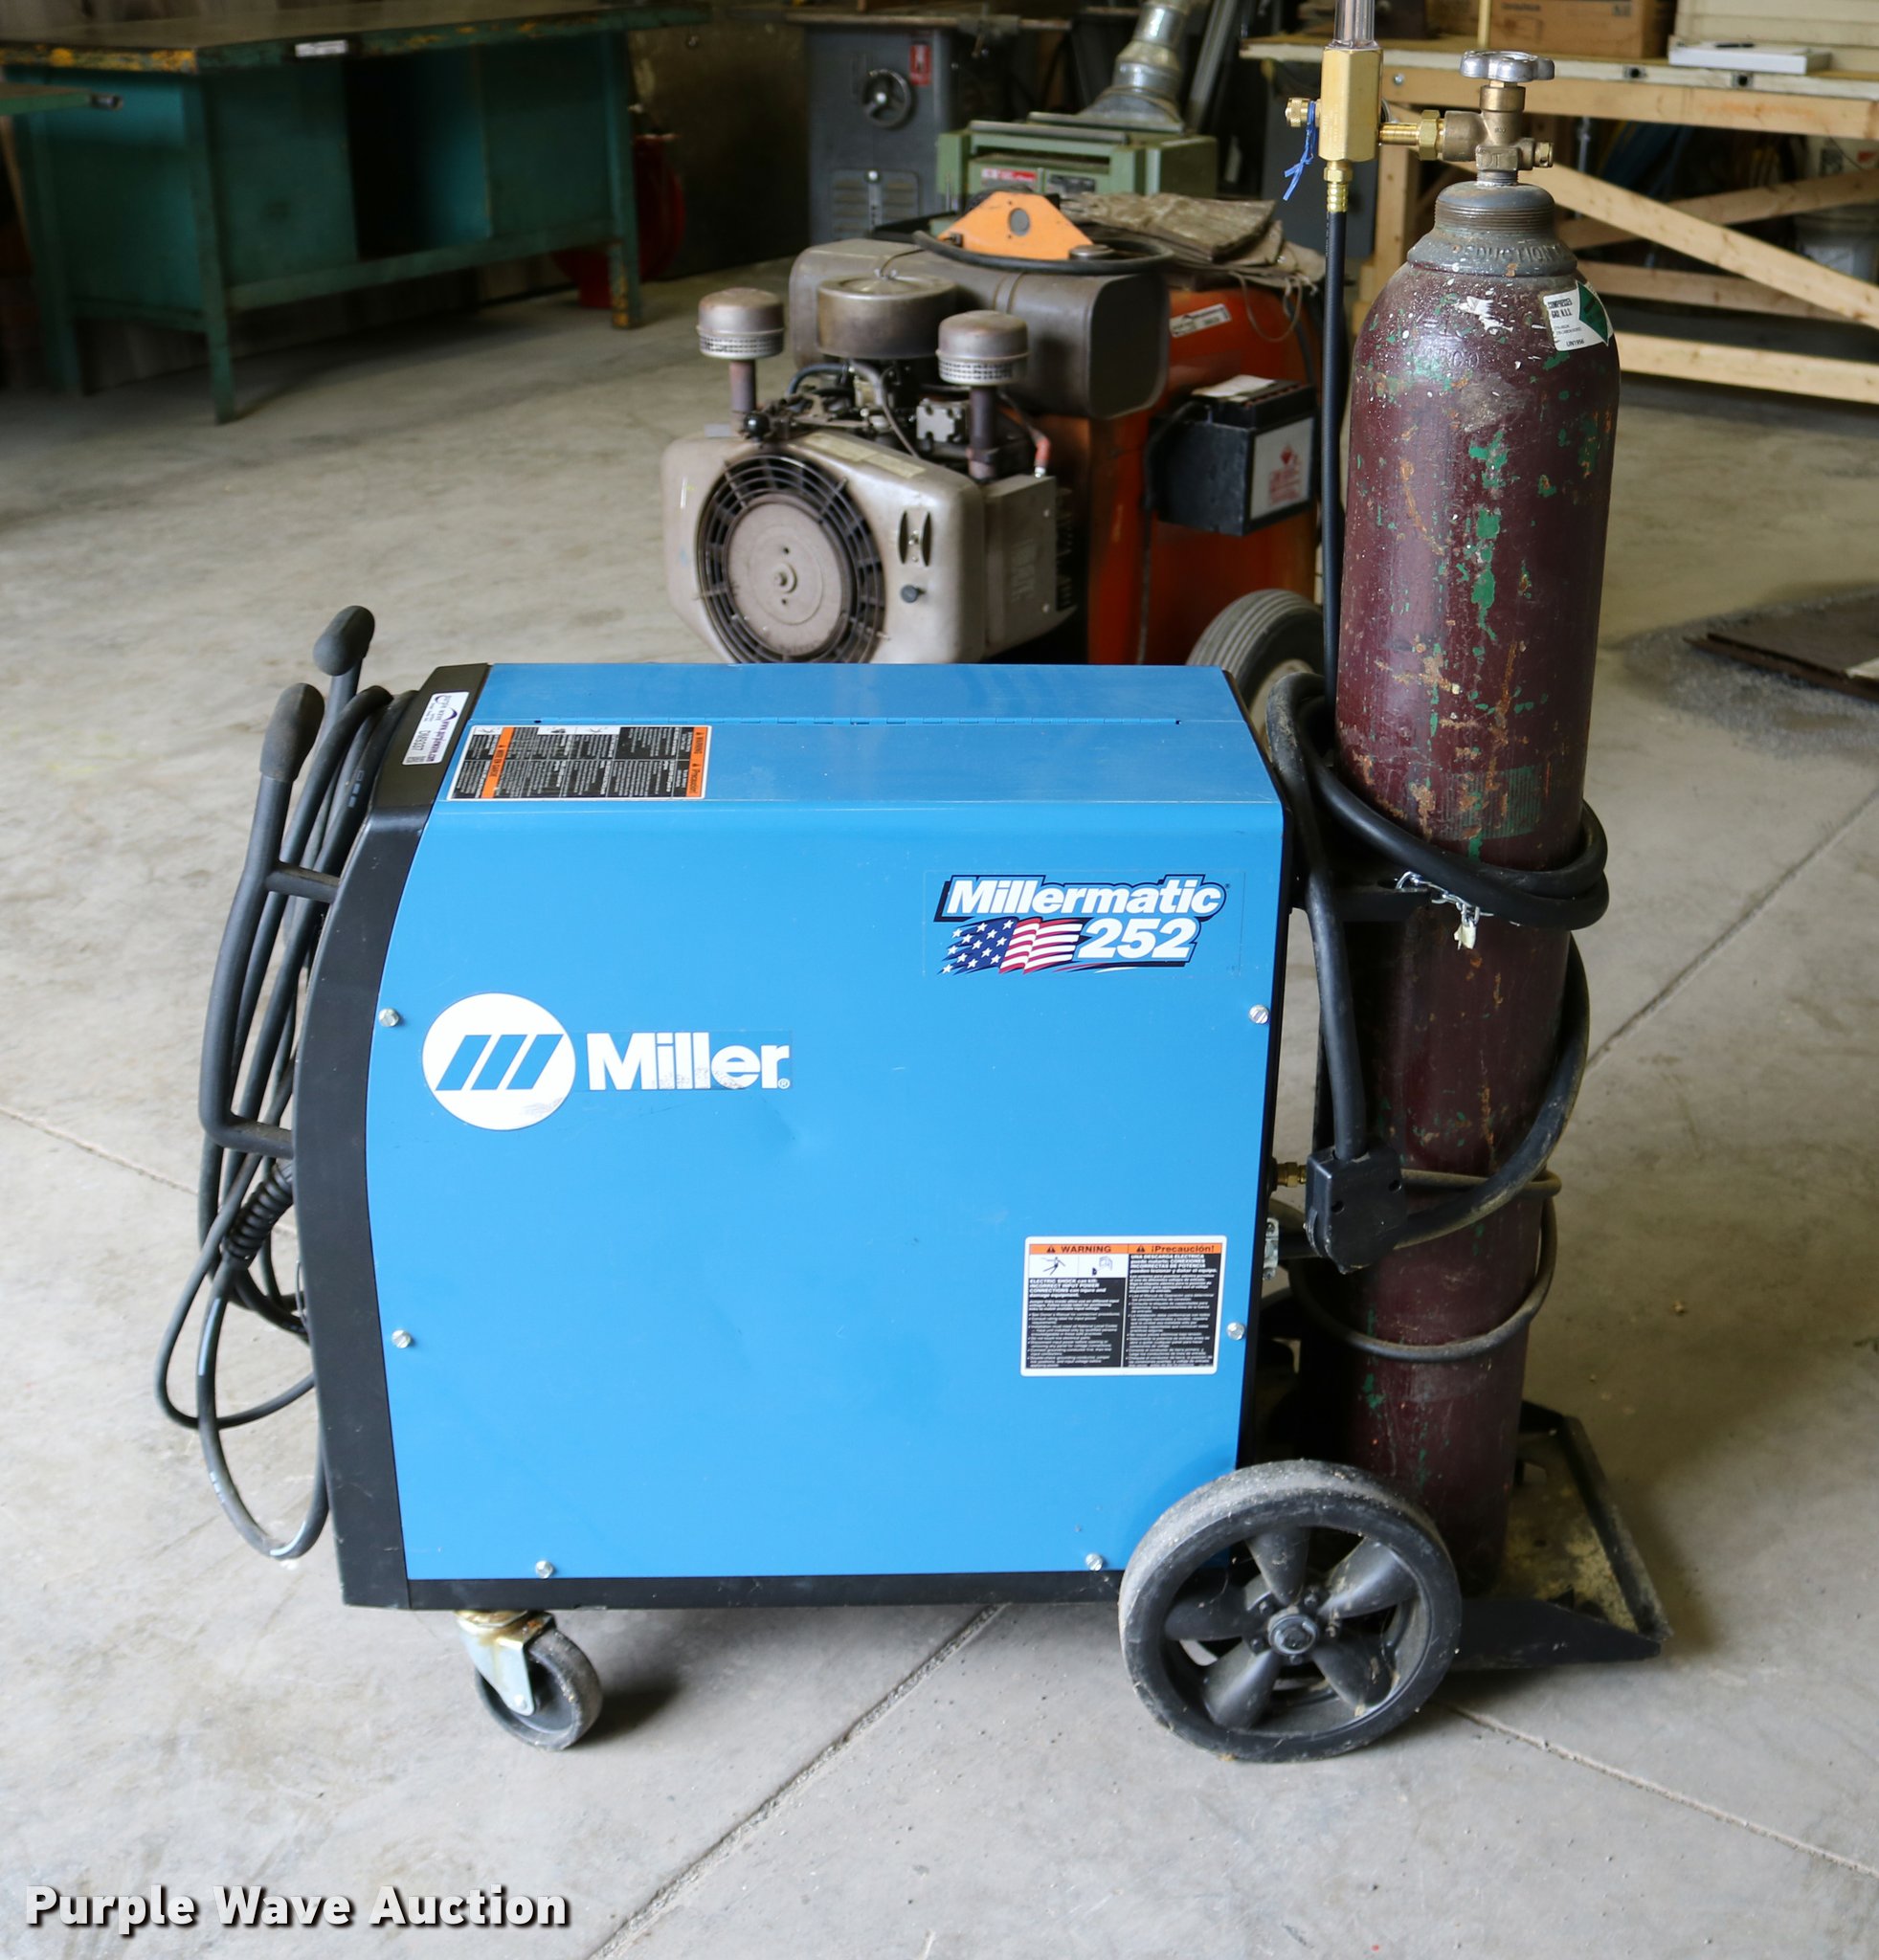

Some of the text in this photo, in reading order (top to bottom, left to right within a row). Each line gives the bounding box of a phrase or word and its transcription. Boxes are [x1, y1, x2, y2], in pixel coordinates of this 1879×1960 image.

[947, 880, 1221, 914] Millermatic
[1077, 918, 1197, 959] 252
[586, 1032, 790, 1091] Miller
